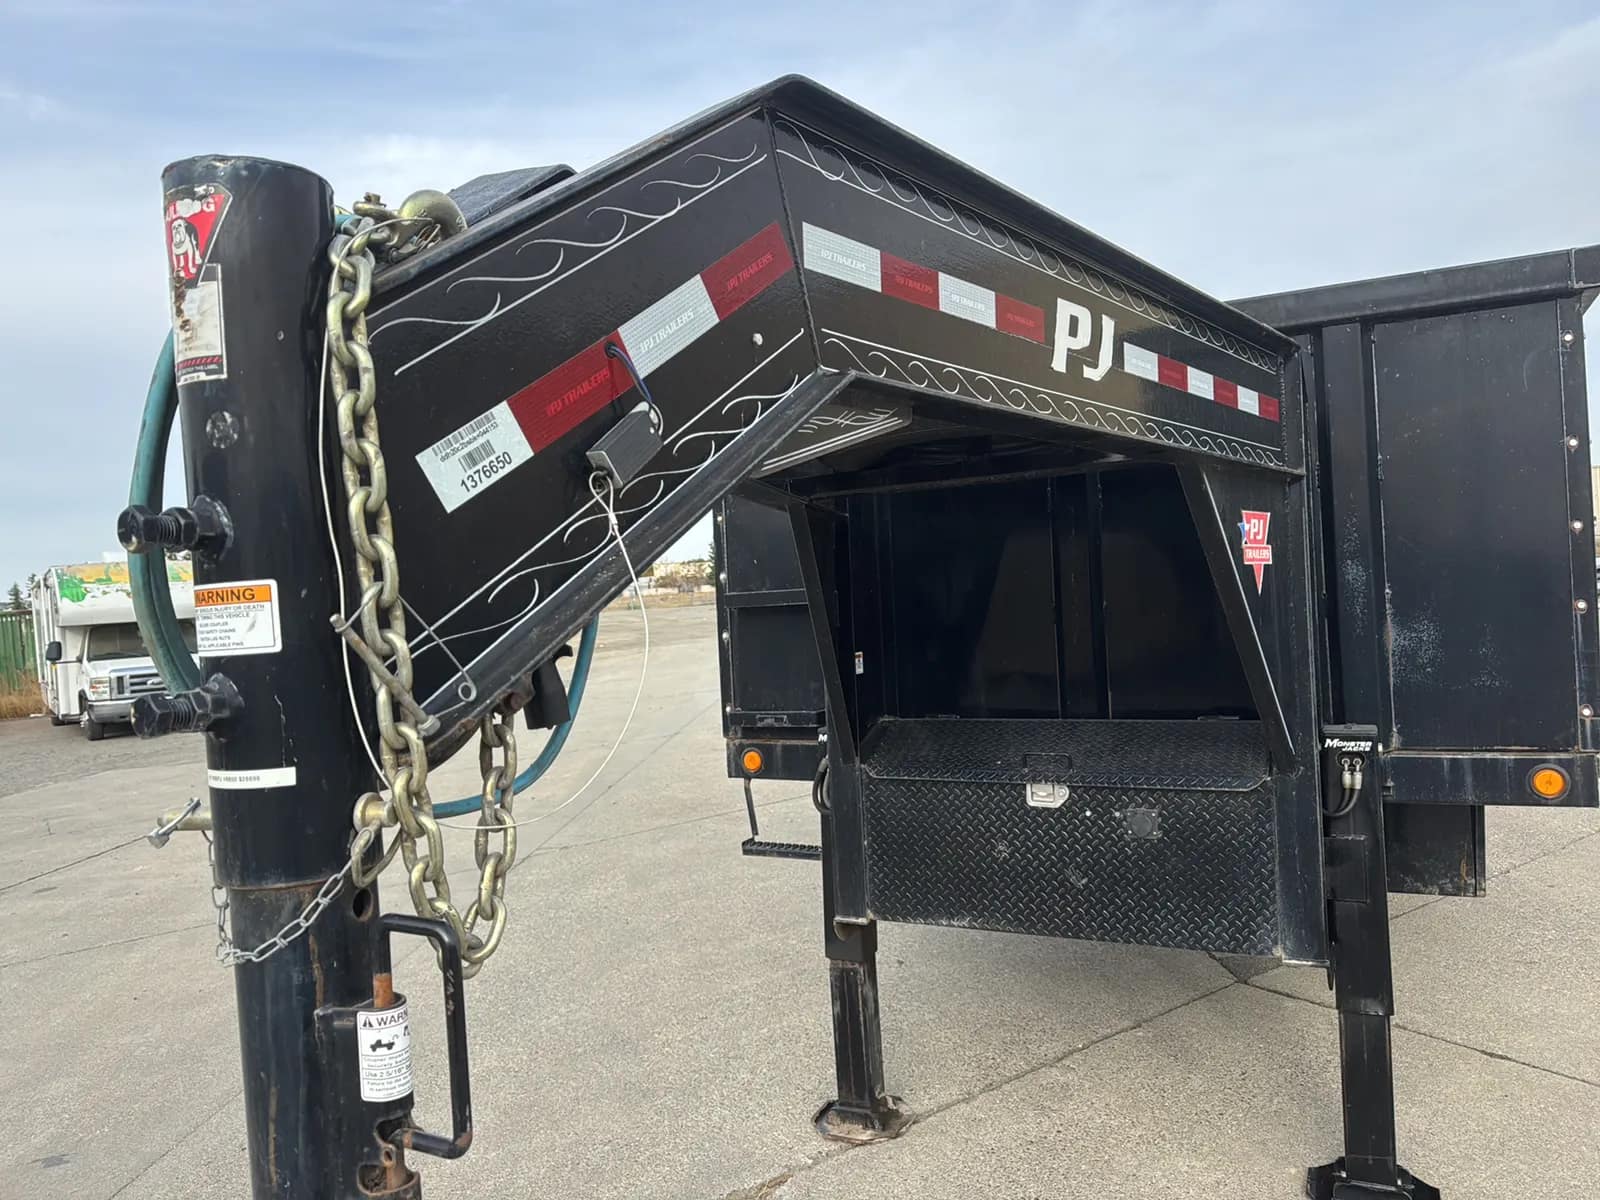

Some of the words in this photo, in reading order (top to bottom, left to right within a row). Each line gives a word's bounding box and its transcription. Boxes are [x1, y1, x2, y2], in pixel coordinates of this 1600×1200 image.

[653, 308, 695, 343] TRAILERS
[1051, 298, 1115, 381] PJ
[460, 451, 513, 493] 1376650
[1250, 519, 1264, 540] PJ
[1245, 550, 1270, 559] TRAILERS
